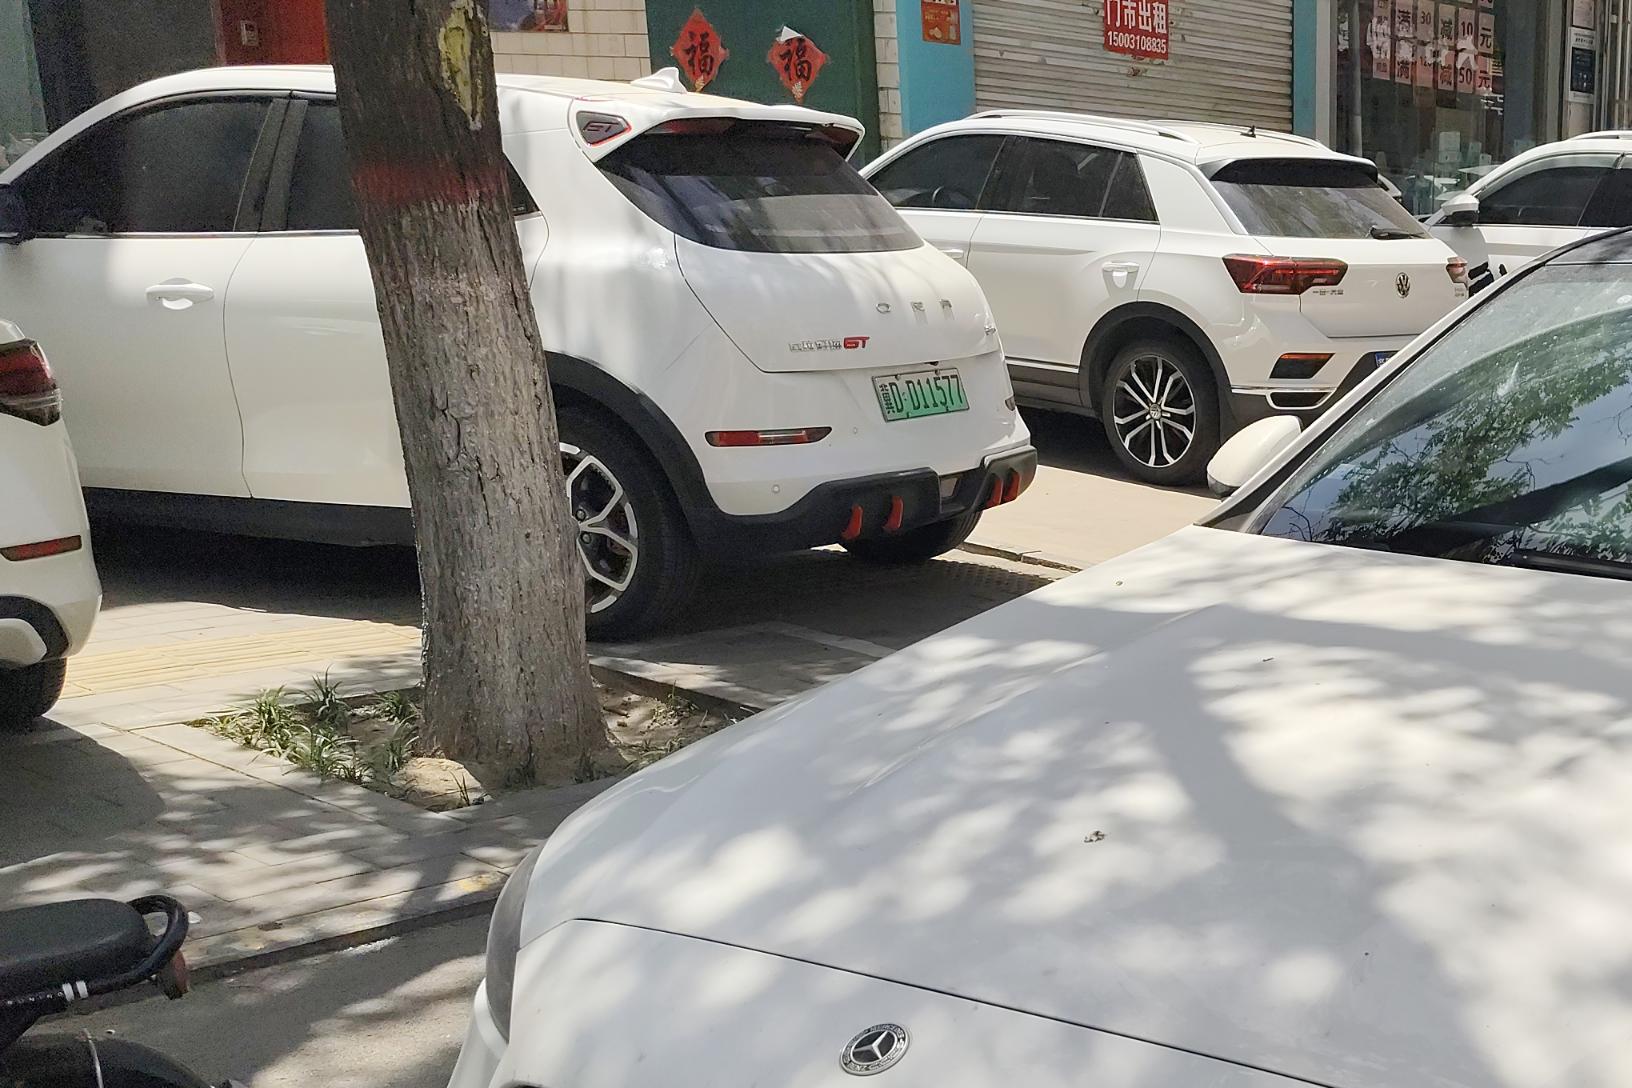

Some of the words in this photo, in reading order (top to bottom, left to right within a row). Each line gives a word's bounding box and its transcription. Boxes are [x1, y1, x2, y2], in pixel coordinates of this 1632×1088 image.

[1107, 0, 1167, 33] 门市出租
[686, 31, 715, 75] 福
[1107, 31, 1167, 54] 15003108835
[779, 38, 812, 82] 福
[843, 336, 870, 349] GT
